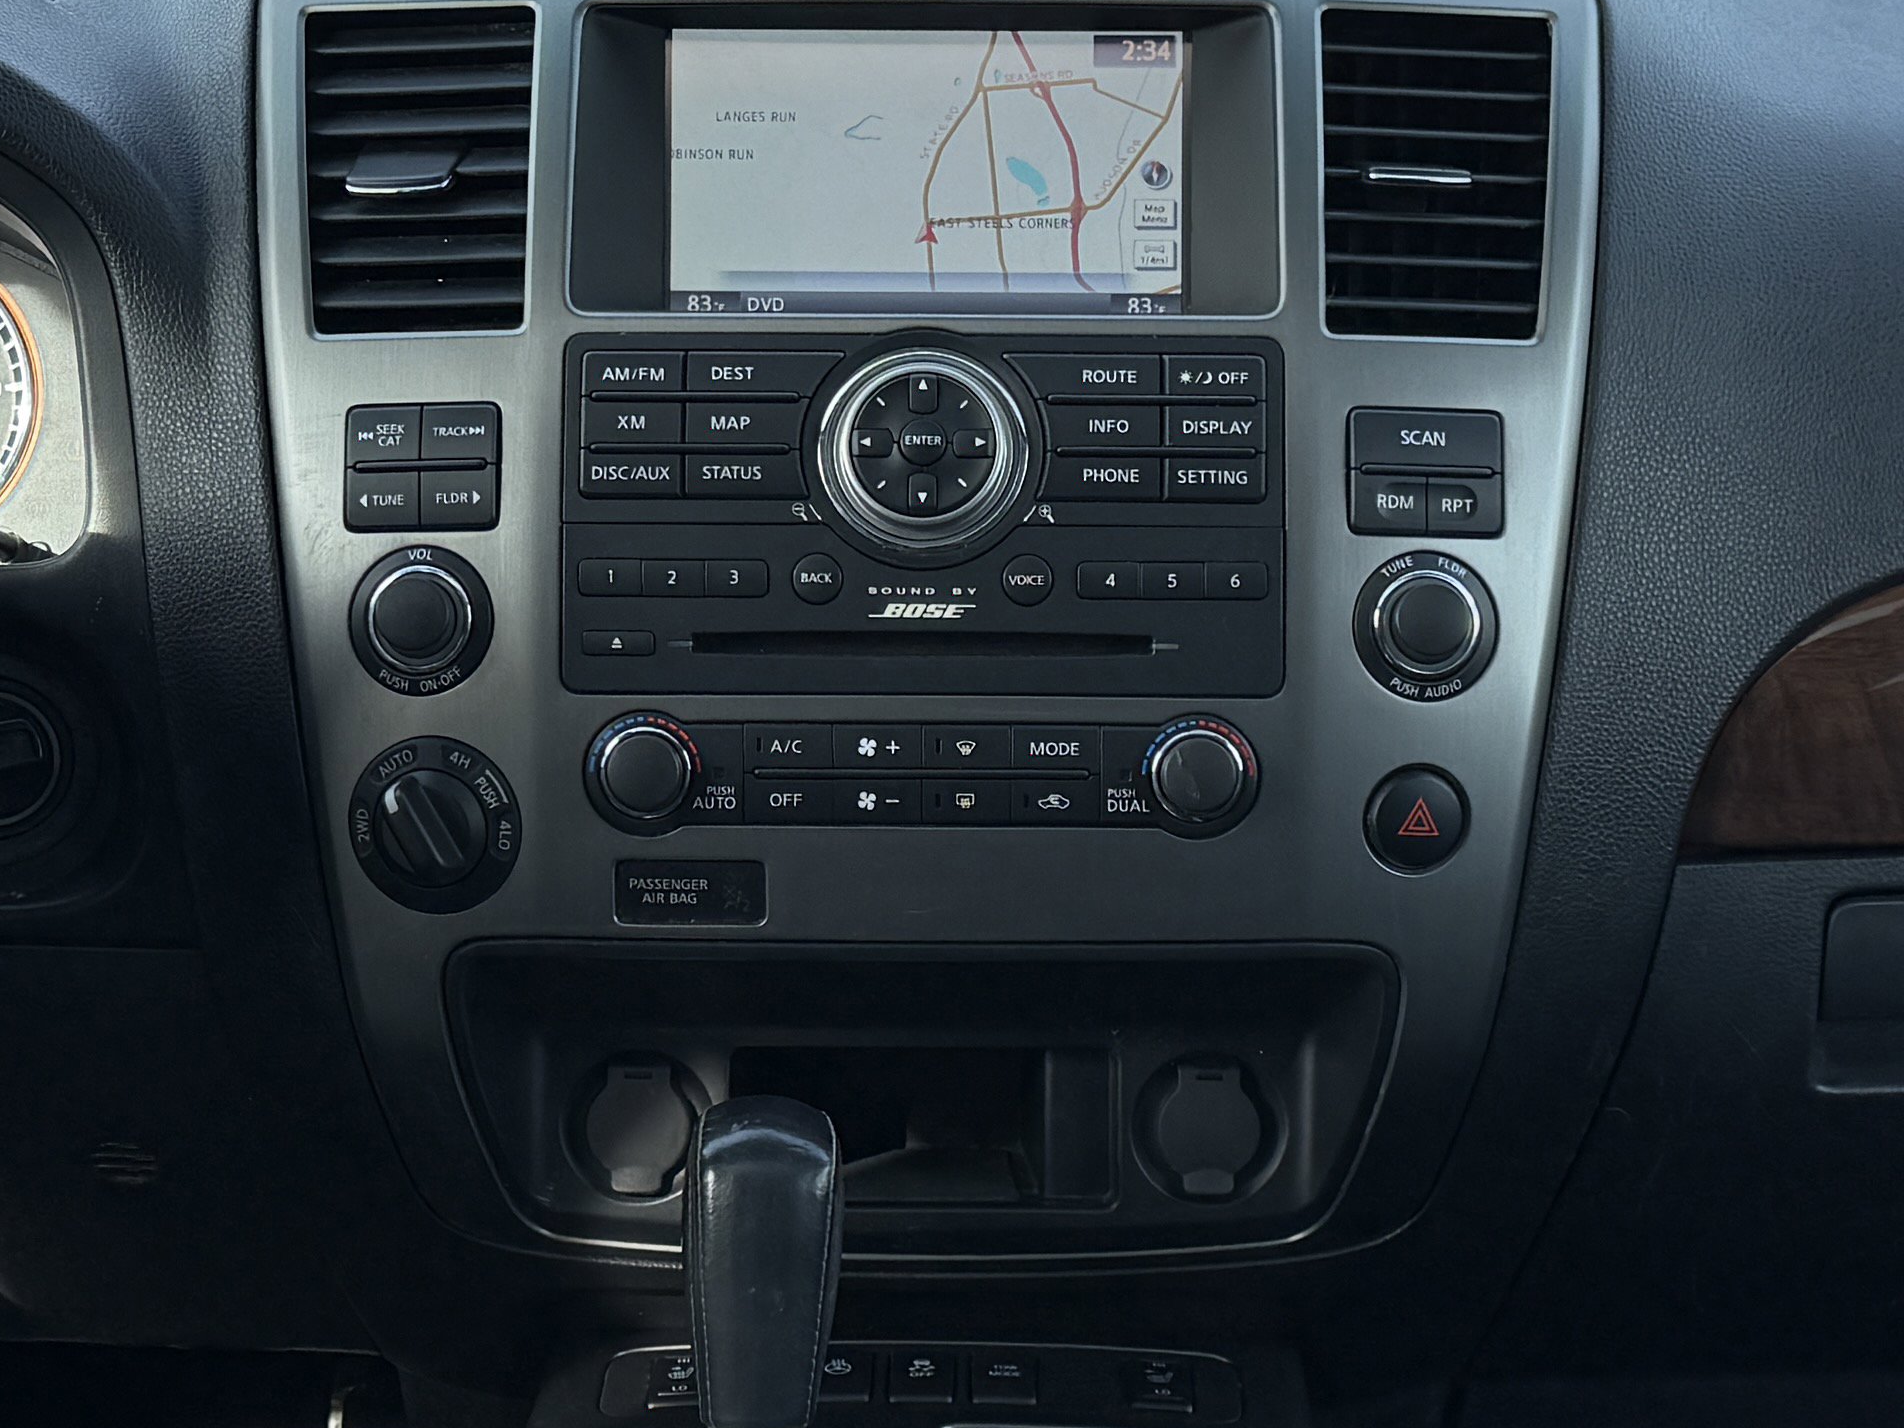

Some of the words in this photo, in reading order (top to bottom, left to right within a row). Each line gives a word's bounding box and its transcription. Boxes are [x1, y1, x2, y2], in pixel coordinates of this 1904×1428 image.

[1122, 40, 1172, 62] 2:34
[716, 112, 765, 122] LANGES
[771, 112, 796, 122] RUN
[728, 149, 754, 160] RUN
[930, 218, 963, 228] EAST
[967, 217, 1013, 229] STEELS
[1019, 217, 1076, 229] CORNERS
[747, 297, 785, 312] DVD
[602, 365, 666, 381] AM/FM
[710, 365, 755, 380] DEST
[1082, 369, 1138, 384] ROUTE
[1217, 370, 1249, 385] OFF
[617, 415, 646, 429] XM
[710, 415, 751, 430] MAP
[1088, 419, 1130, 434] INFO
[1182, 419, 1253, 436] DISPLAY
[376, 424, 406, 436] SEEK
[432, 425, 469, 438] TRACK
[378, 435, 403, 448] CAT
[904, 434, 943, 447] ENTER
[1400, 429, 1446, 447] SCAN
[591, 465, 671, 482] DISC/AUX
[702, 465, 763, 481] STATUS
[1082, 468, 1141, 484] PHONE
[1177, 469, 1249, 486] SETTING
[372, 493, 405, 507] TUNE
[435, 492, 469, 506] FLDR
[1377, 493, 1414, 511] RDM
[1441, 497, 1474, 514] RPT
[408, 548, 434, 561] VOL
[1380, 555, 1415, 579] TUNE
[1438, 556, 1468, 579] FLDR
[607, 569, 614, 584] 1
[666, 570, 677, 585] 2
[728, 570, 739, 585] 3
[799, 572, 833, 585] BACK
[1008, 573, 1045, 588] VOICE
[1105, 573, 1116, 589] 4
[1167, 573, 1177, 589] 5
[1230, 574, 1241, 589] 6
[867, 586, 936, 596] SOUND
[951, 586, 978, 596] BY
[868, 603, 977, 619] BOSE
[379, 668, 410, 693] PUSH
[1390, 677, 1420, 698] PUSH
[1425, 678, 1463, 699] AUDIO
[770, 738, 803, 756] A/C
[1029, 741, 1081, 758] MODE
[377, 749, 414, 778] AUTO
[449, 750, 471, 771] 4H
[474, 774, 499, 811] PUSH
[706, 785, 736, 796] PUSH
[1107, 788, 1137, 798] PUSH
[692, 795, 737, 811] AUTO
[769, 792, 803, 808] OFF
[1106, 798, 1150, 814] DUAL
[356, 807, 371, 842] 2WD
[498, 818, 512, 851] 4LO
[628, 877, 709, 890] PASSENGER
[642, 893, 665, 904] AIR
[669, 893, 698, 905] BAG
